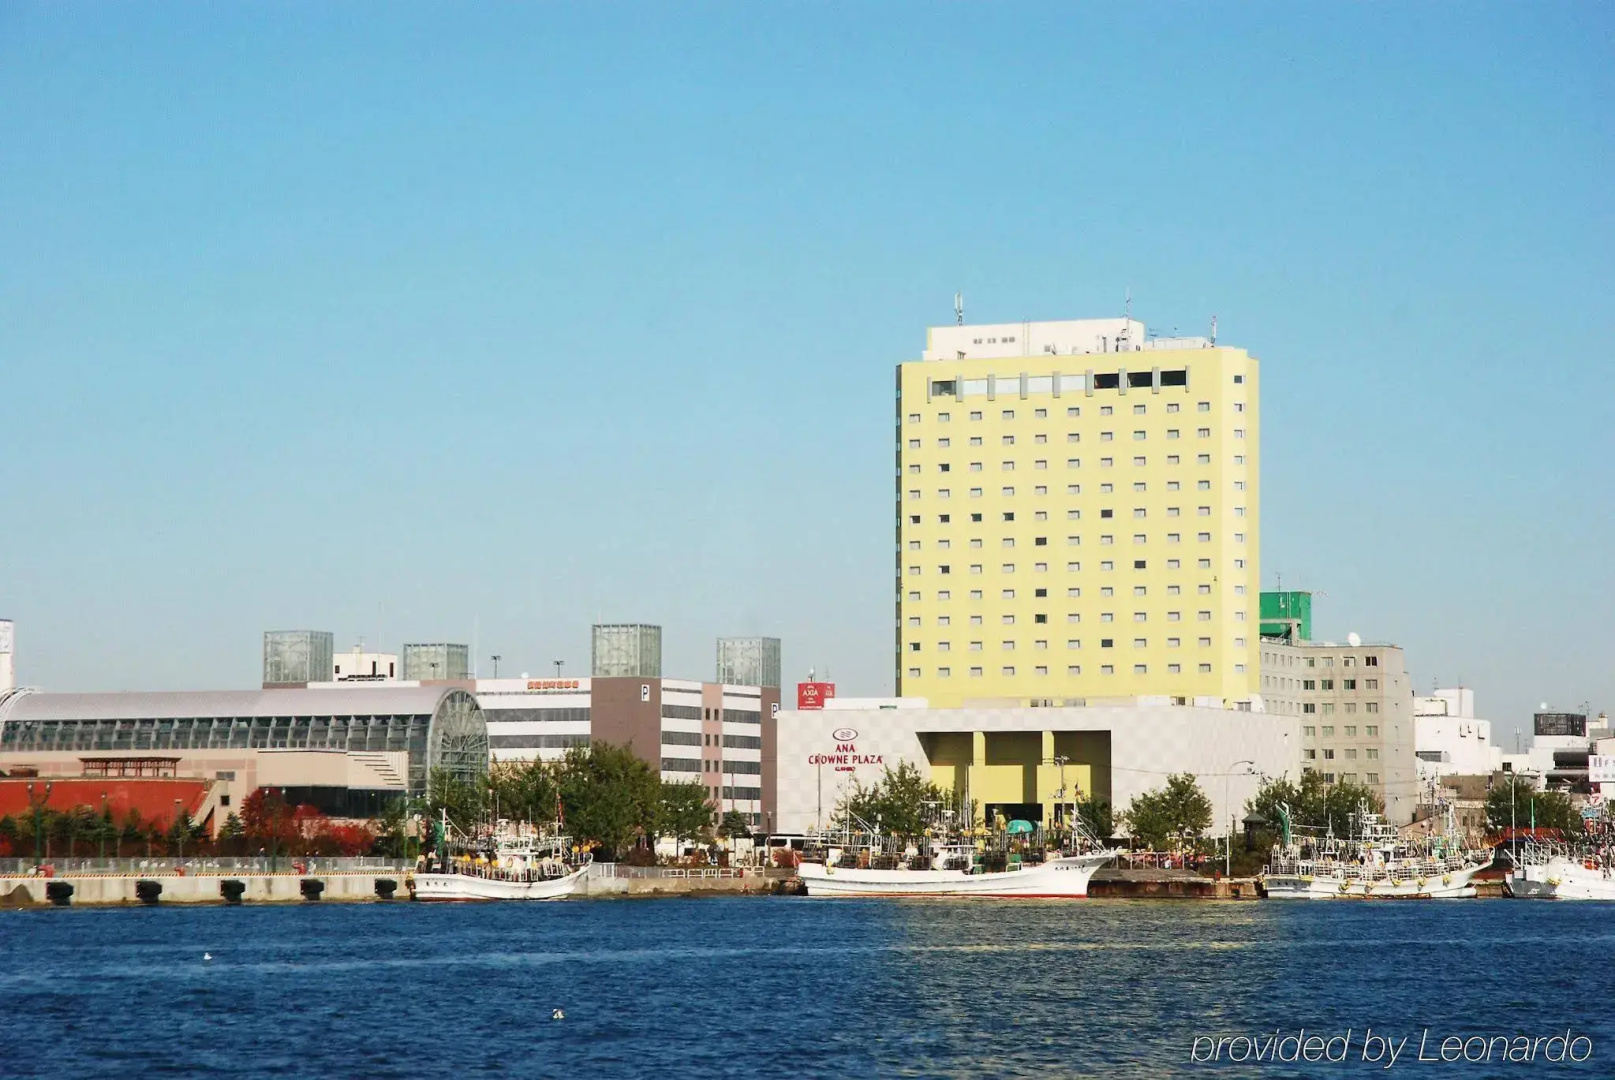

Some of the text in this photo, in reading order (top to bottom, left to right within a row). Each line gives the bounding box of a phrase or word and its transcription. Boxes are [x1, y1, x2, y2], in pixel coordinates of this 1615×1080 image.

[835, 744, 856, 753] ANA
[808, 755, 883, 764] CROWNE PLAZA
